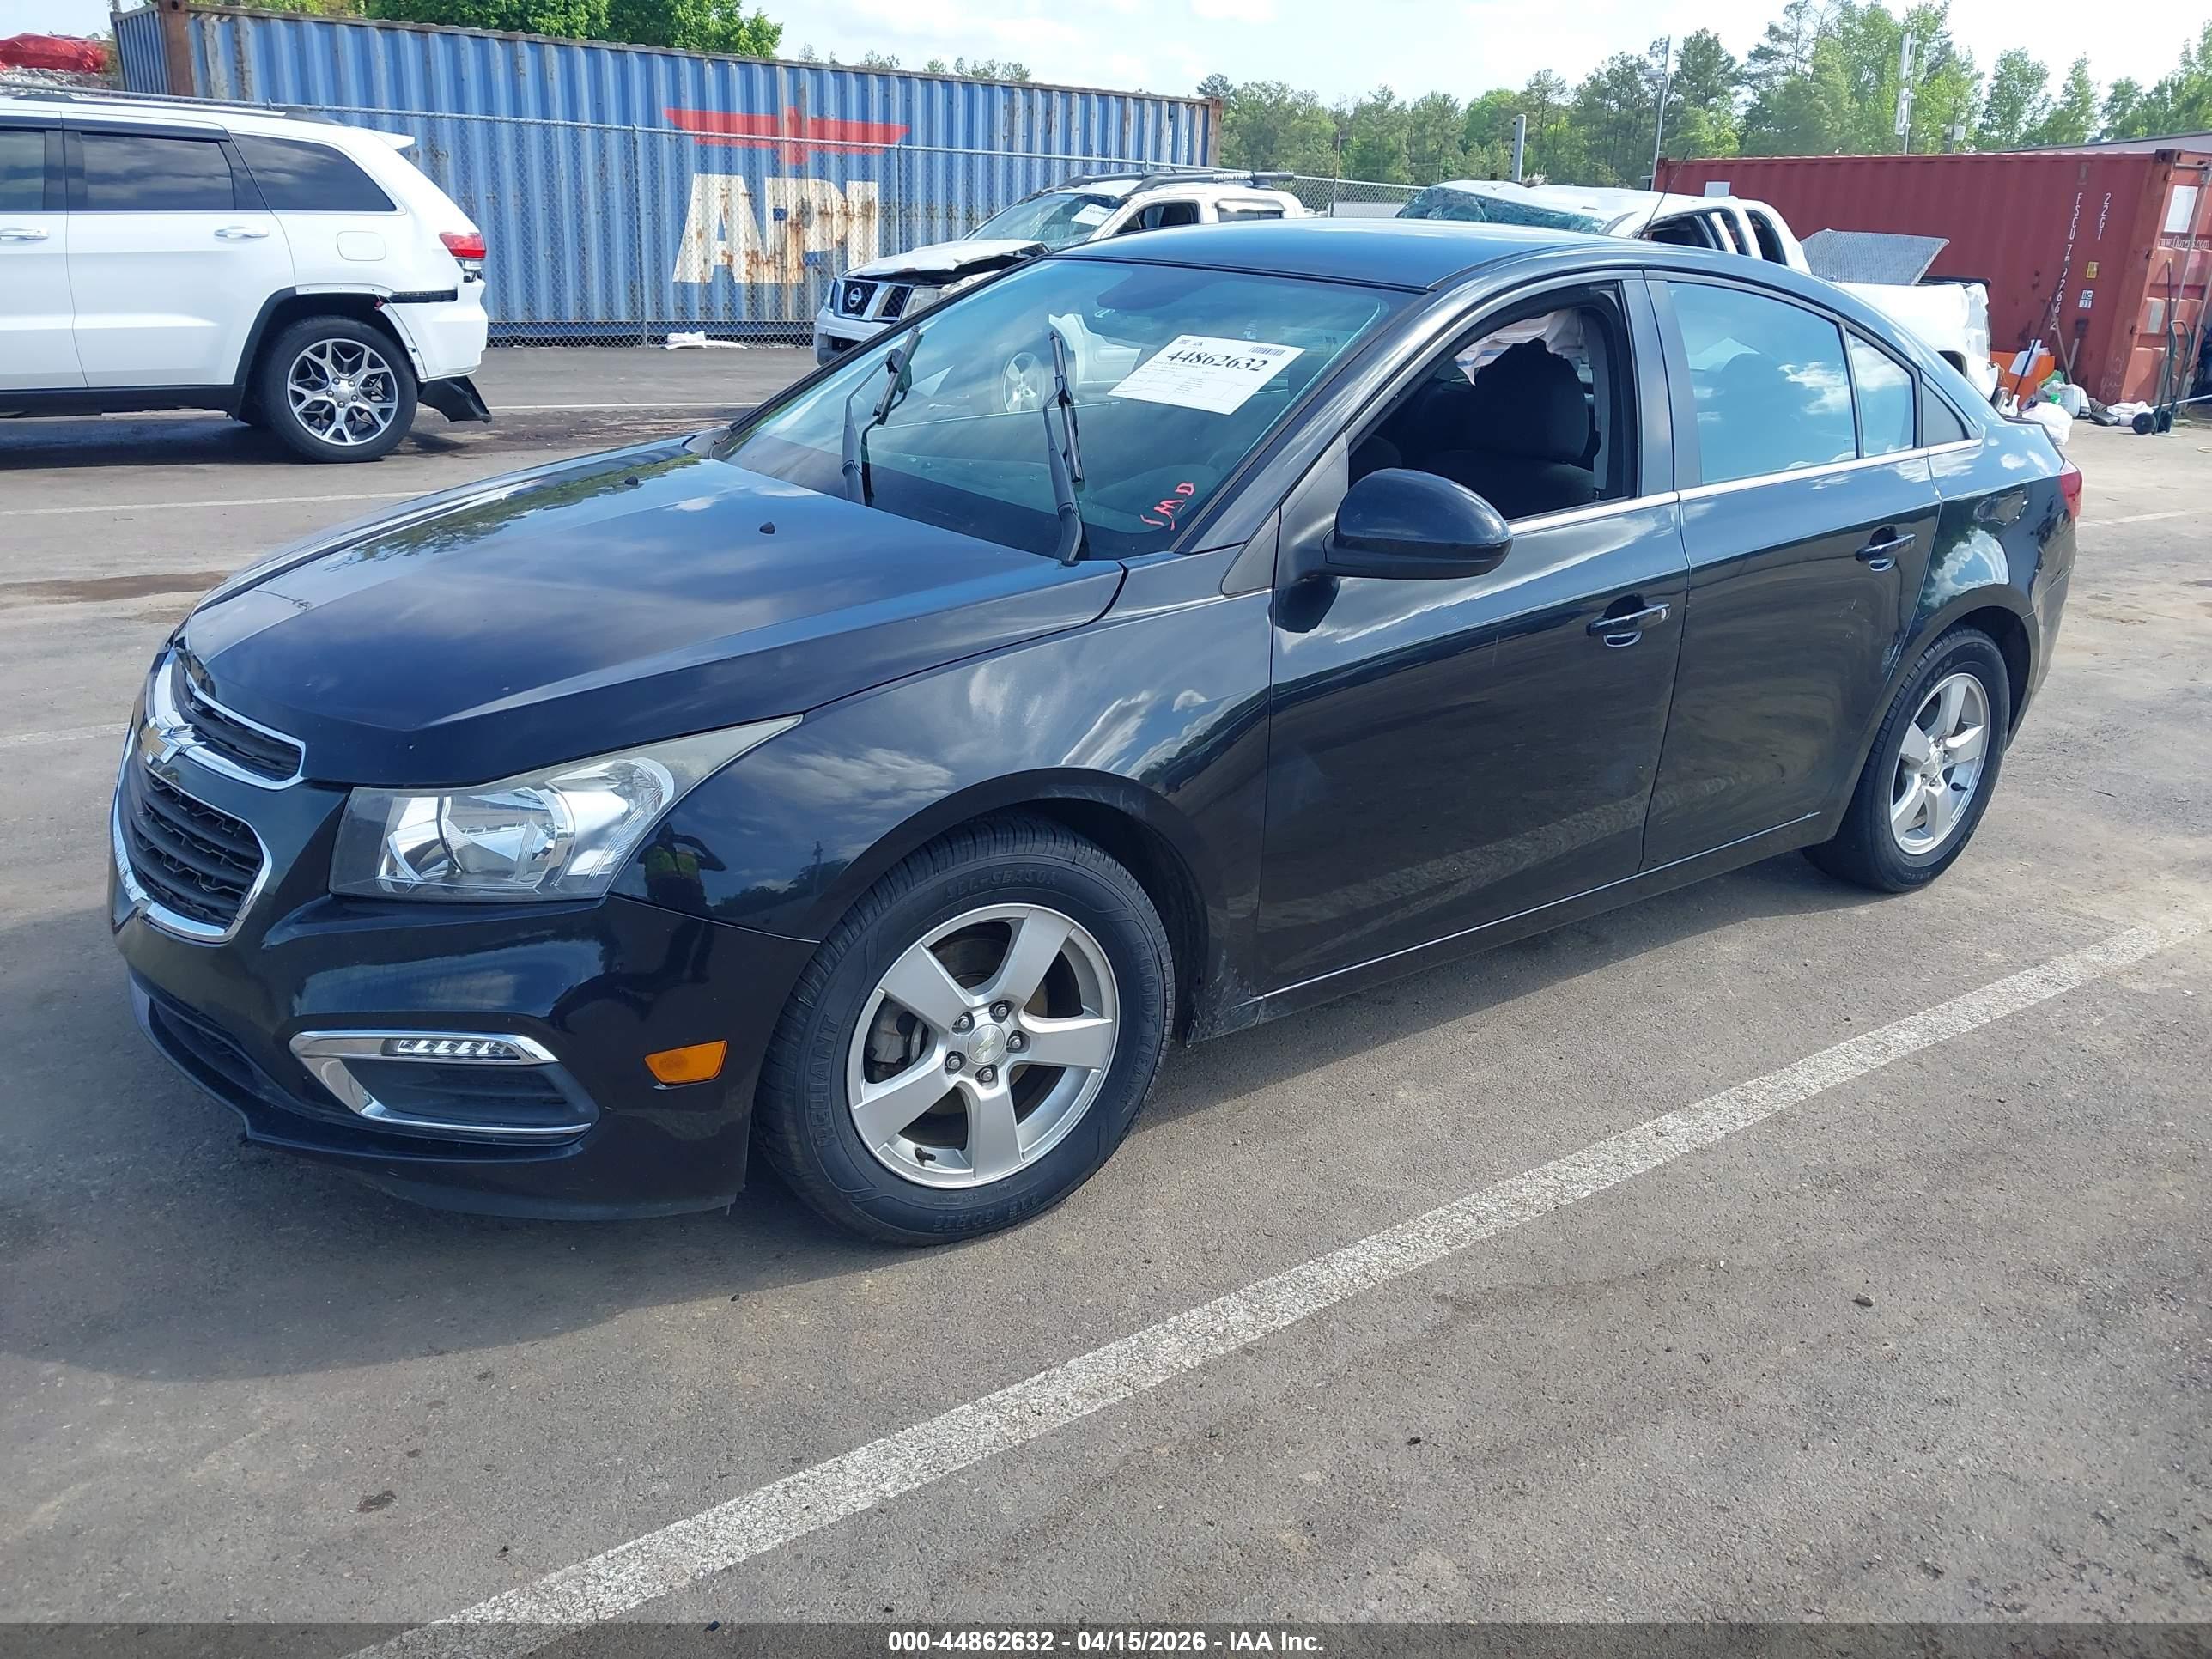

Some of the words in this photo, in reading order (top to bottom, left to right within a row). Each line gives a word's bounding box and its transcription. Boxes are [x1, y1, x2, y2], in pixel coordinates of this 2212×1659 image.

[2069, 192, 2083, 240] FSCU
[1167, 349, 1268, 372] 44862632
[808, 1013, 841, 1149] RELIANT
